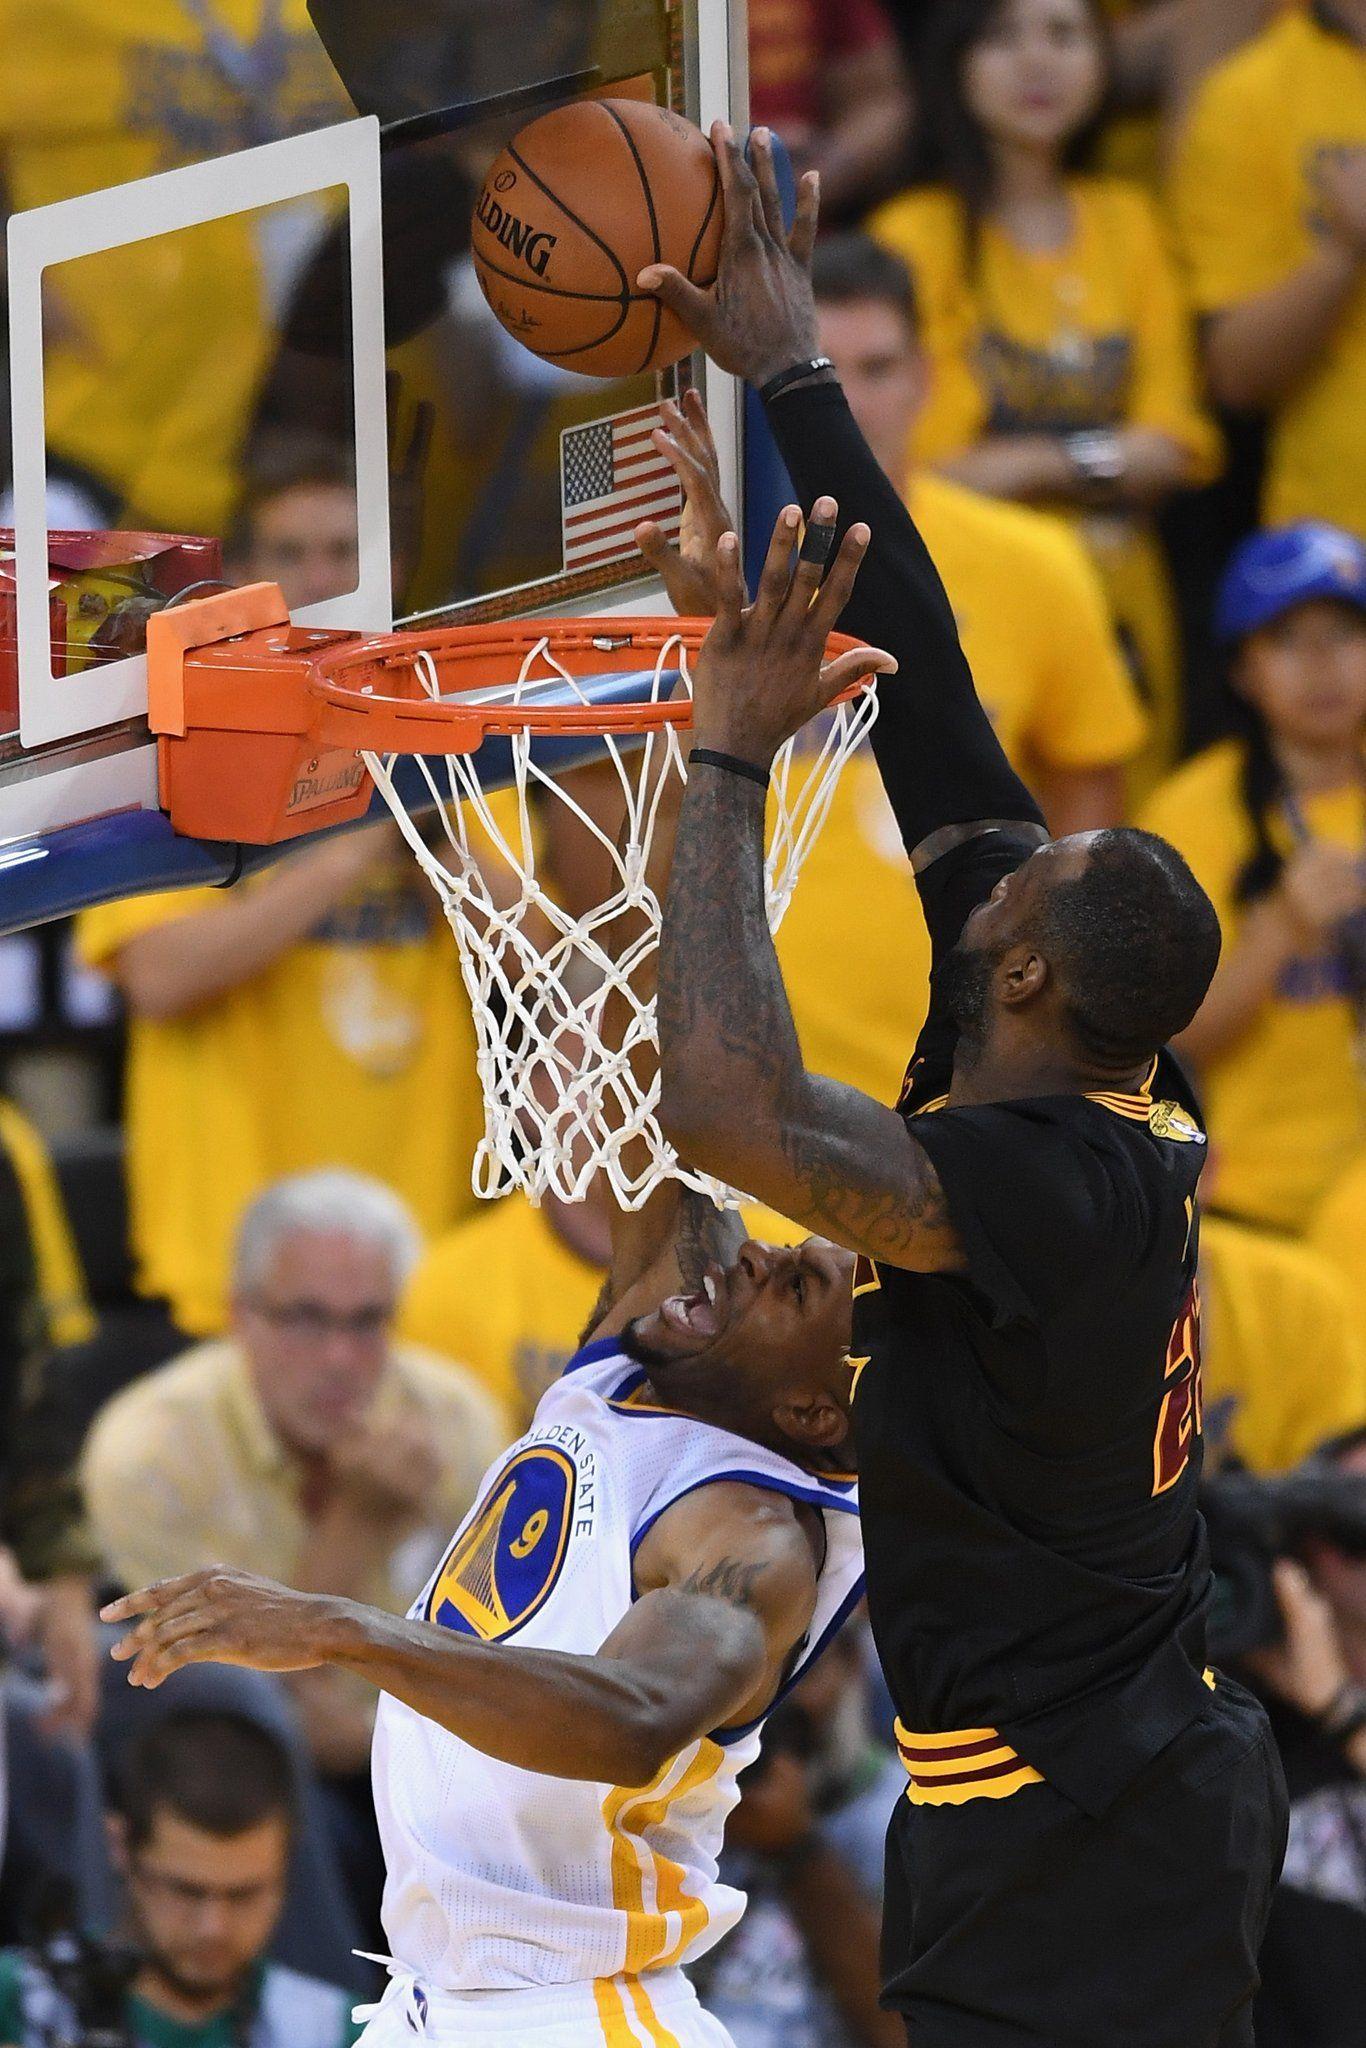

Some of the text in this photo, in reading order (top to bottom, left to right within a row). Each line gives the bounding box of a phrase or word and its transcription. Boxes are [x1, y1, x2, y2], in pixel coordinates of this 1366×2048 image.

[476, 186, 558, 277] LDING
[509, 1509, 549, 1560] 9
[575, 1453, 596, 1538] STATE
